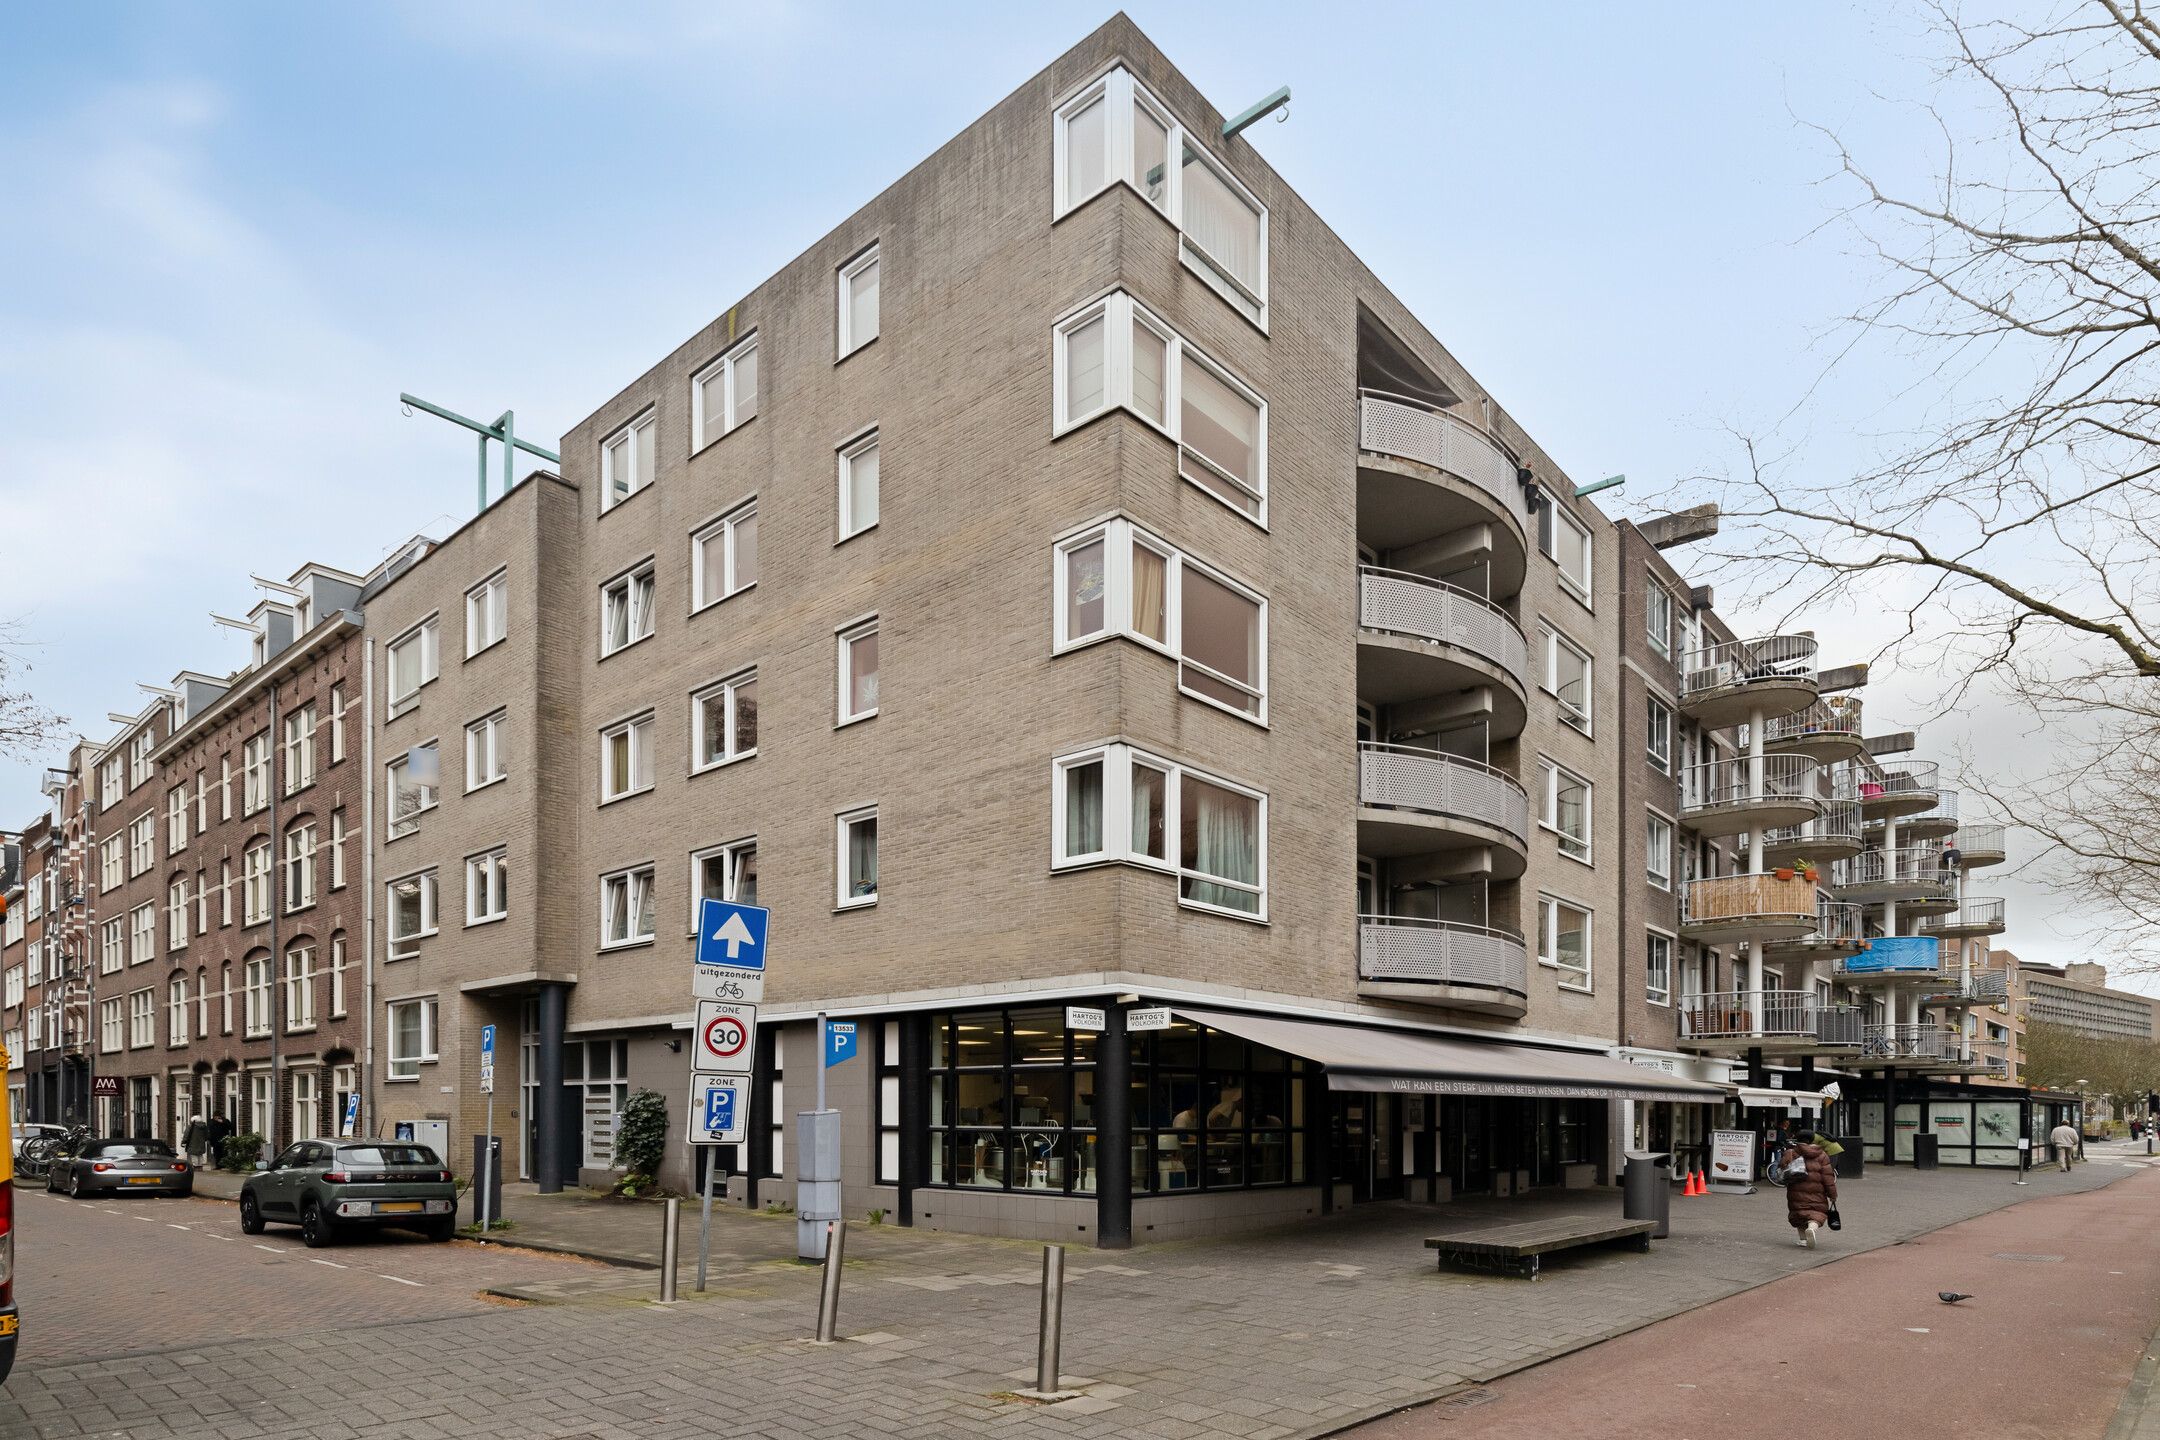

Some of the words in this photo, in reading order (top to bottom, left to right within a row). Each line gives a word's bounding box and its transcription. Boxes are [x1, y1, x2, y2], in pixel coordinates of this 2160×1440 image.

[700, 968, 761, 981] uitgezonderd
[715, 1005, 741, 1014] ZONE
[1072, 1013, 1103, 1021] HARTOG'S
[1129, 1013, 1165, 1021] HARTOG'S
[483, 1029, 491, 1050] P
[712, 1028, 740, 1046] 30
[835, 1034, 848, 1053] P
[709, 1078, 736, 1086] ZONE
[1391, 1079, 1411, 1090] WAT
[1414, 1080, 1432, 1091] KAN
[1434, 1081, 1451, 1092] EEN
[1494, 1085, 1515, 1094] MENS
[1516, 1085, 1536, 1095] BETER
[1566, 1087, 1580, 1096] DAN
[348, 1096, 357, 1113] P
[711, 1091, 729, 1113] P
